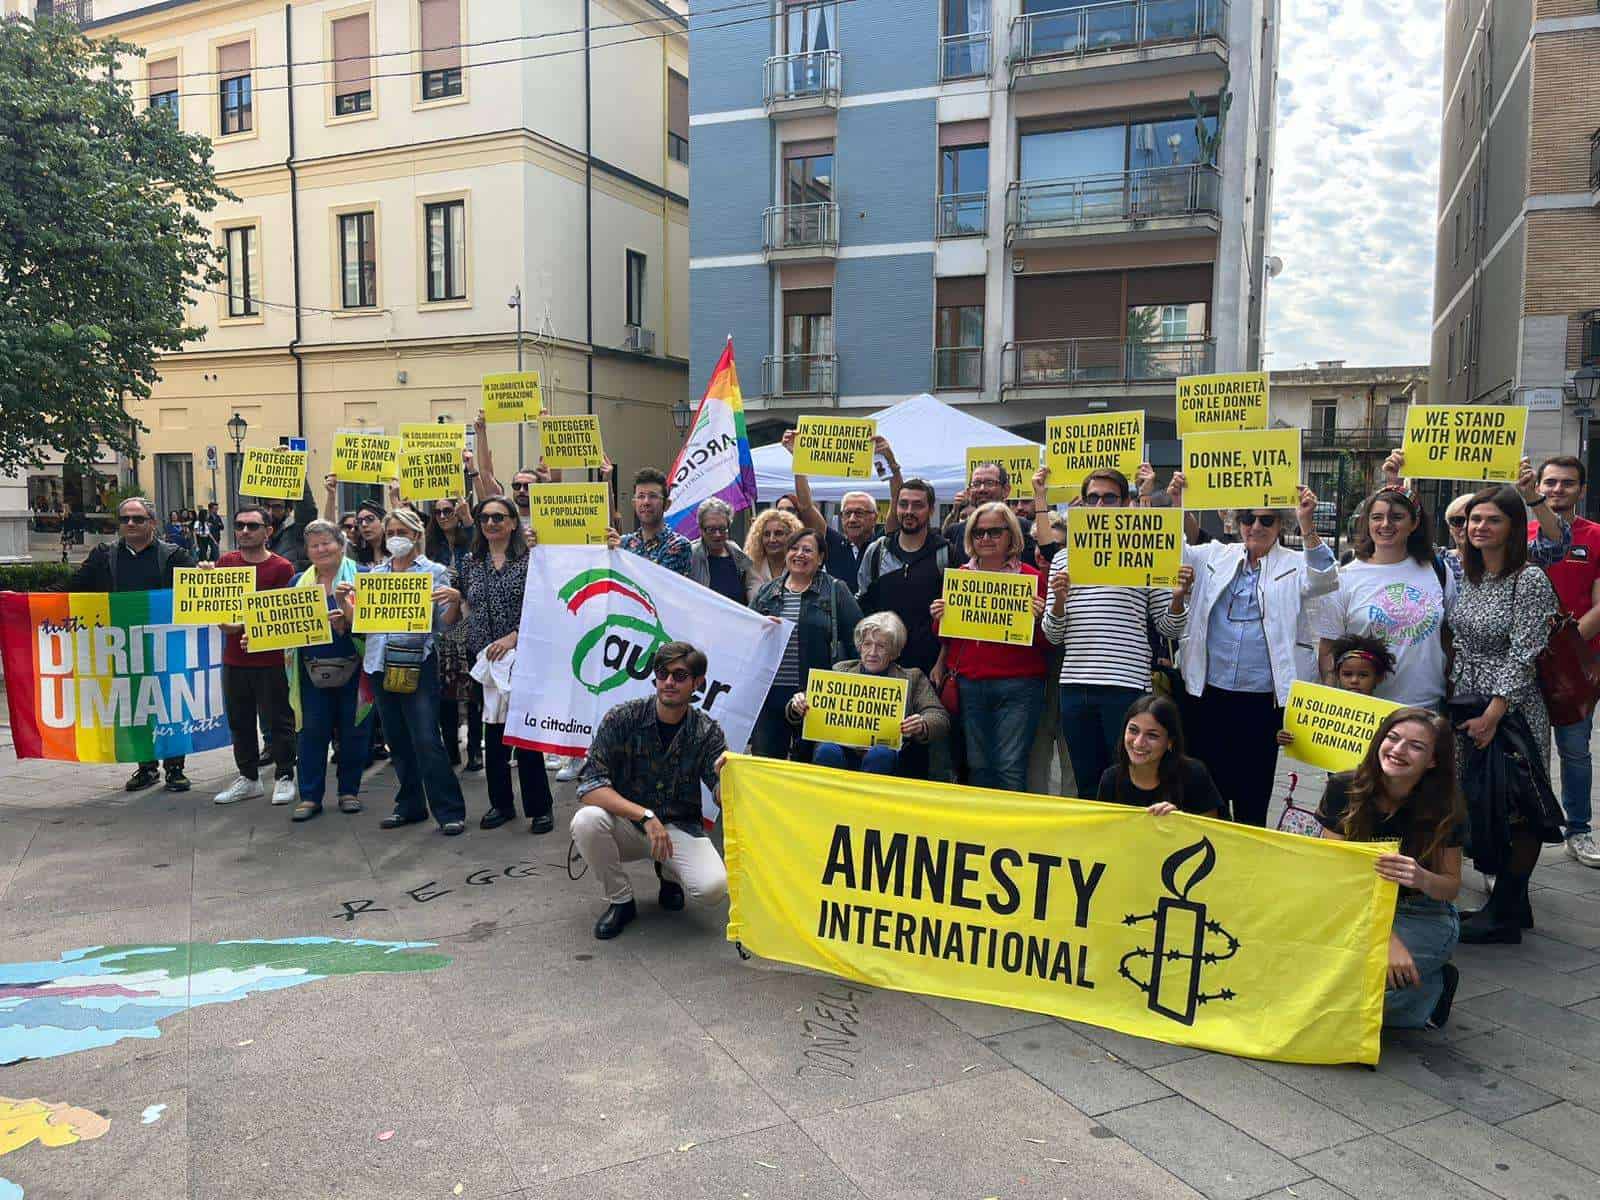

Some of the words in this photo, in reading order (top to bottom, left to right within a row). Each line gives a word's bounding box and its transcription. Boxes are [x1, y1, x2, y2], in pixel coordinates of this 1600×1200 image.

[487, 392, 494, 400] LA
[495, 391, 534, 399] POPOLAZIONE
[1180, 386, 1190, 397] IN
[1194, 378, 1265, 396] SOLIDARIETÀ
[1182, 398, 1203, 410] CON
[1208, 396, 1219, 408] LE
[1224, 394, 1262, 408] DONNE
[1195, 409, 1246, 423] IRANIANE
[1426, 411, 1449, 426] WE
[1454, 412, 1504, 428] STAND
[542, 419, 596, 431] PROTEGGERE
[800, 424, 808, 436] IN
[812, 424, 873, 438] SOLIDARIETÀ
[1050, 426, 1062, 440] IN
[1066, 418, 1140, 439] SOLIDARIETÀ
[344, 437, 358, 448] WE
[361, 438, 390, 450] STAND
[548, 434, 556, 444] IL
[558, 432, 591, 444] DIRITTO
[800, 438, 818, 449] CON
[822, 438, 833, 450] LE
[836, 440, 868, 451] DONNE
[1411, 428, 1450, 443] WITH
[1456, 429, 1516, 446] WOMEN
[546, 446, 554, 456] DI
[556, 445, 598, 457] PROTESTA
[1053, 441, 1076, 455] CON
[1080, 440, 1092, 454] LE
[1097, 438, 1136, 452] DONNE
[1428, 446, 1448, 460] OF
[1455, 446, 1492, 462] IRAN
[250, 452, 304, 465] PROTEGGERE
[337, 448, 360, 460] WITH
[362, 450, 396, 462] WOMEN
[408, 456, 421, 466] WE
[424, 452, 452, 464] STAND
[810, 452, 854, 464] IRANIANE
[1067, 454, 1120, 470] IRANIANE
[1190, 451, 1246, 468] DONNE,
[1252, 450, 1292, 468] VITA,
[255, 465, 262, 474] IL
[266, 466, 298, 477] DIRITTO
[346, 460, 358, 470] OF
[361, 461, 382, 472] IRAN
[402, 466, 424, 478] WITH
[426, 464, 460, 476] WOMEN
[1010, 458, 1035, 472] VITA,
[247, 476, 257, 486] DI
[260, 478, 300, 489] PROTESTA
[414, 478, 424, 488] OF
[428, 477, 450, 488] IRAN
[1208, 467, 1272, 488] LIBERTÀ
[533, 496, 542, 504] IN
[544, 493, 588, 504] SOLIDARIETÀ
[590, 495, 604, 504] CON
[540, 508, 549, 516] LA
[551, 506, 598, 516] POPOLAZIONE
[554, 519, 586, 528] IRANIANA
[1086, 514, 1109, 530] WE
[1115, 514, 1162, 530] STAND
[1074, 532, 1111, 549] WITH
[1118, 532, 1175, 550] WOMEN
[1094, 552, 1112, 568] OF
[1118, 552, 1154, 568] IRAN
[180, 572, 250, 584] PROTEGGERE
[360, 578, 428, 591] PROTEGGERE
[188, 586, 198, 598] IL
[202, 586, 244, 598] DIRITTO
[947, 578, 958, 590] IN
[962, 581, 1033, 597] SOLIDARIETÀ
[180, 601, 192, 612] DI
[196, 600, 243, 612] PROTEST
[248, 590, 320, 609] PROTEGGERE
[368, 593, 376, 604] IL
[380, 592, 420, 604] DIRITTO
[948, 593, 970, 606] CON
[974, 596, 987, 608] LE
[992, 598, 1028, 612] DONNE
[256, 610, 266, 623] IL
[270, 606, 314, 622] DIRITTO
[360, 608, 371, 620] DI
[374, 606, 426, 620] PROTESTA
[962, 610, 1013, 626] IRANIANE
[40, 616, 88, 634] tutti
[94, 614, 104, 628] i
[252, 624, 263, 638] DI
[266, 622, 324, 636] PROTESTA
[38, 624, 223, 676] DIRITTI
[603, 634, 732, 711] aur
[40, 668, 225, 728] UMANI
[811, 680, 822, 692] IN
[827, 681, 902, 702] SOLIDARIETÀ
[812, 696, 836, 710] CON
[840, 698, 852, 712] LE
[857, 700, 897, 718] DONNE
[1292, 697, 1304, 708] IN
[1305, 699, 1376, 726] SOLIDARIETÀ
[524, 712, 536, 727] La
[540, 716, 592, 735] cittadina
[825, 712, 880, 731] IRANIANE
[1297, 714, 1308, 726] LA
[1312, 716, 1374, 741] POPOLAZIO
[152, 724, 176, 744] per
[181, 716, 224, 733] tutti
[1312, 732, 1362, 754] IRANIANA
[821, 824, 1107, 928] AMNESTY
[816, 900, 1095, 990] INTERNATIONAL
